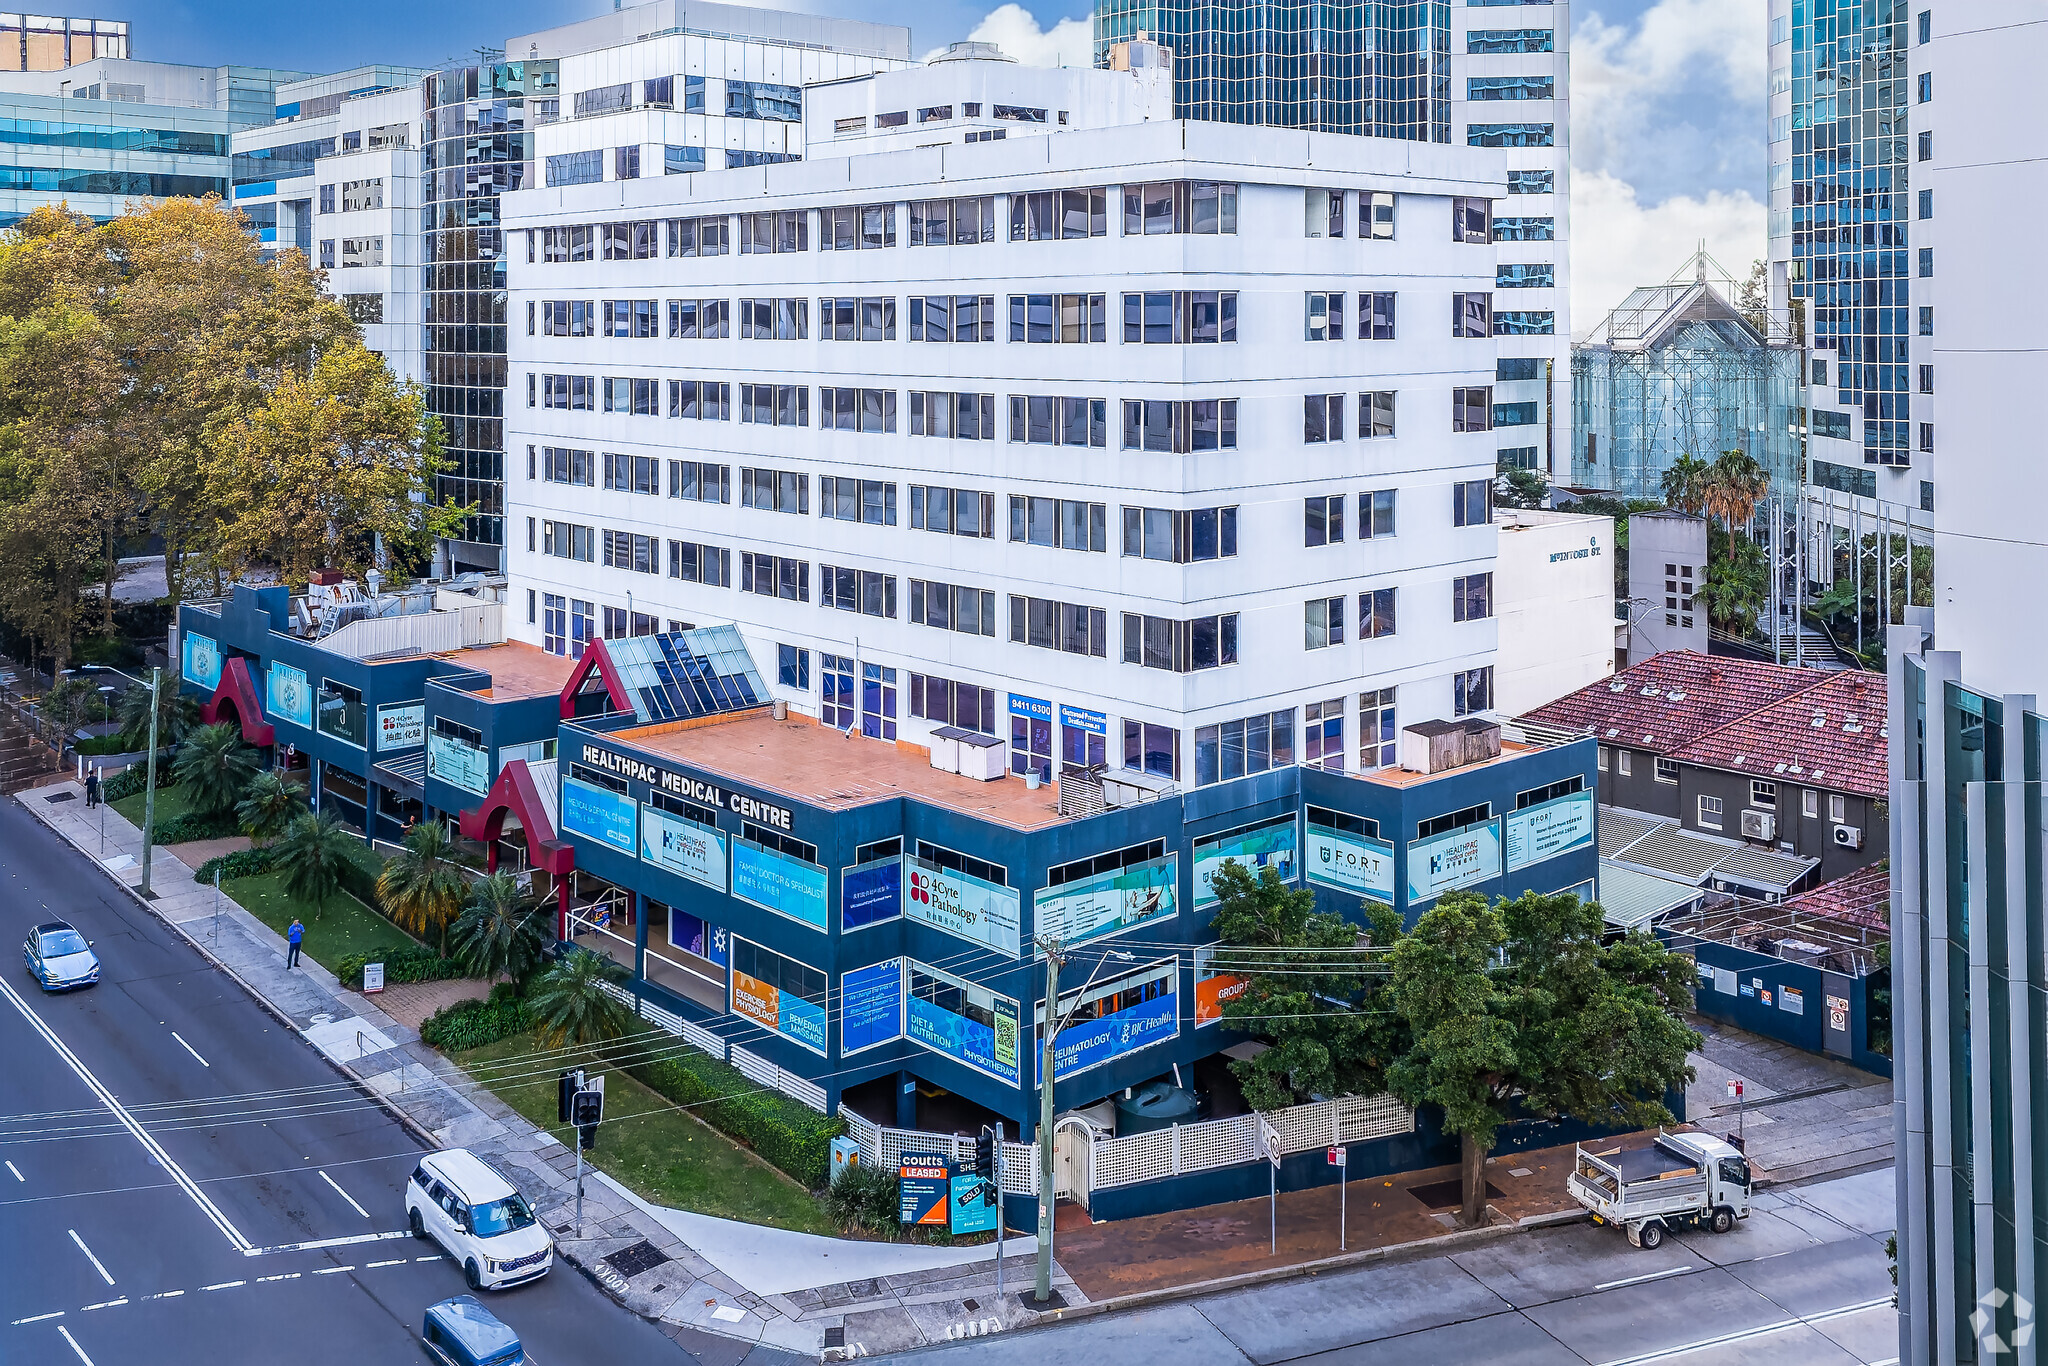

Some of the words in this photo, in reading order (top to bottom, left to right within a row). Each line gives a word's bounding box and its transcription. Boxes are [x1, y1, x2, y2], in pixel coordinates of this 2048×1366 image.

[1590, 536, 1596, 546] 6
[1012, 699, 1030, 711] 9411
[1031, 703, 1051, 716] 6300
[583, 744, 656, 784] HEALTHPAC
[661, 769, 724, 808] MEDICAL
[730, 794, 791, 831] CENTRE
[593, 806, 611, 820] DENTAL
[612, 812, 632, 827] CENTRE
[1535, 812, 1552, 823] FORT
[676, 832, 706, 850] HEALTHPAC
[1446, 839, 1478, 857] HEALTHPAC
[1335, 849, 1380, 872] FORT
[738, 860, 758, 875] FAMILY
[758, 868, 784, 885] DOCTOR
[784, 878, 790, 888] &
[790, 880, 824, 900] SPECIALIST
[1211, 868, 1224, 879] FO
[931, 878, 959, 899] 4Cyte
[931, 893, 978, 925] Pathology
[735, 988, 767, 1010] EXERCISE
[1218, 982, 1244, 999] GROUP
[735, 998, 777, 1024] PHYSIOLOGY
[789, 1012, 824, 1036] REMEDIAL
[911, 1014, 928, 1029] DIET
[928, 1022, 934, 1032] &
[1130, 1020, 1146, 1036] BJC
[1145, 1010, 1172, 1031] Health
[790, 1022, 824, 1046] MASSAGE
[911, 1026, 952, 1049] NUTRITION
[1054, 1031, 1111, 1060] HEUMATOLOGY
[963, 1048, 1019, 1080] PHYSIOTHERAPY
[1054, 1054, 1079, 1072] ENTRE
[902, 1156, 943, 1166] coutts
[906, 1168, 941, 1178] LEASED
[962, 1187, 981, 1204] SOLD
[597, 1267, 630, 1294] LOOK
